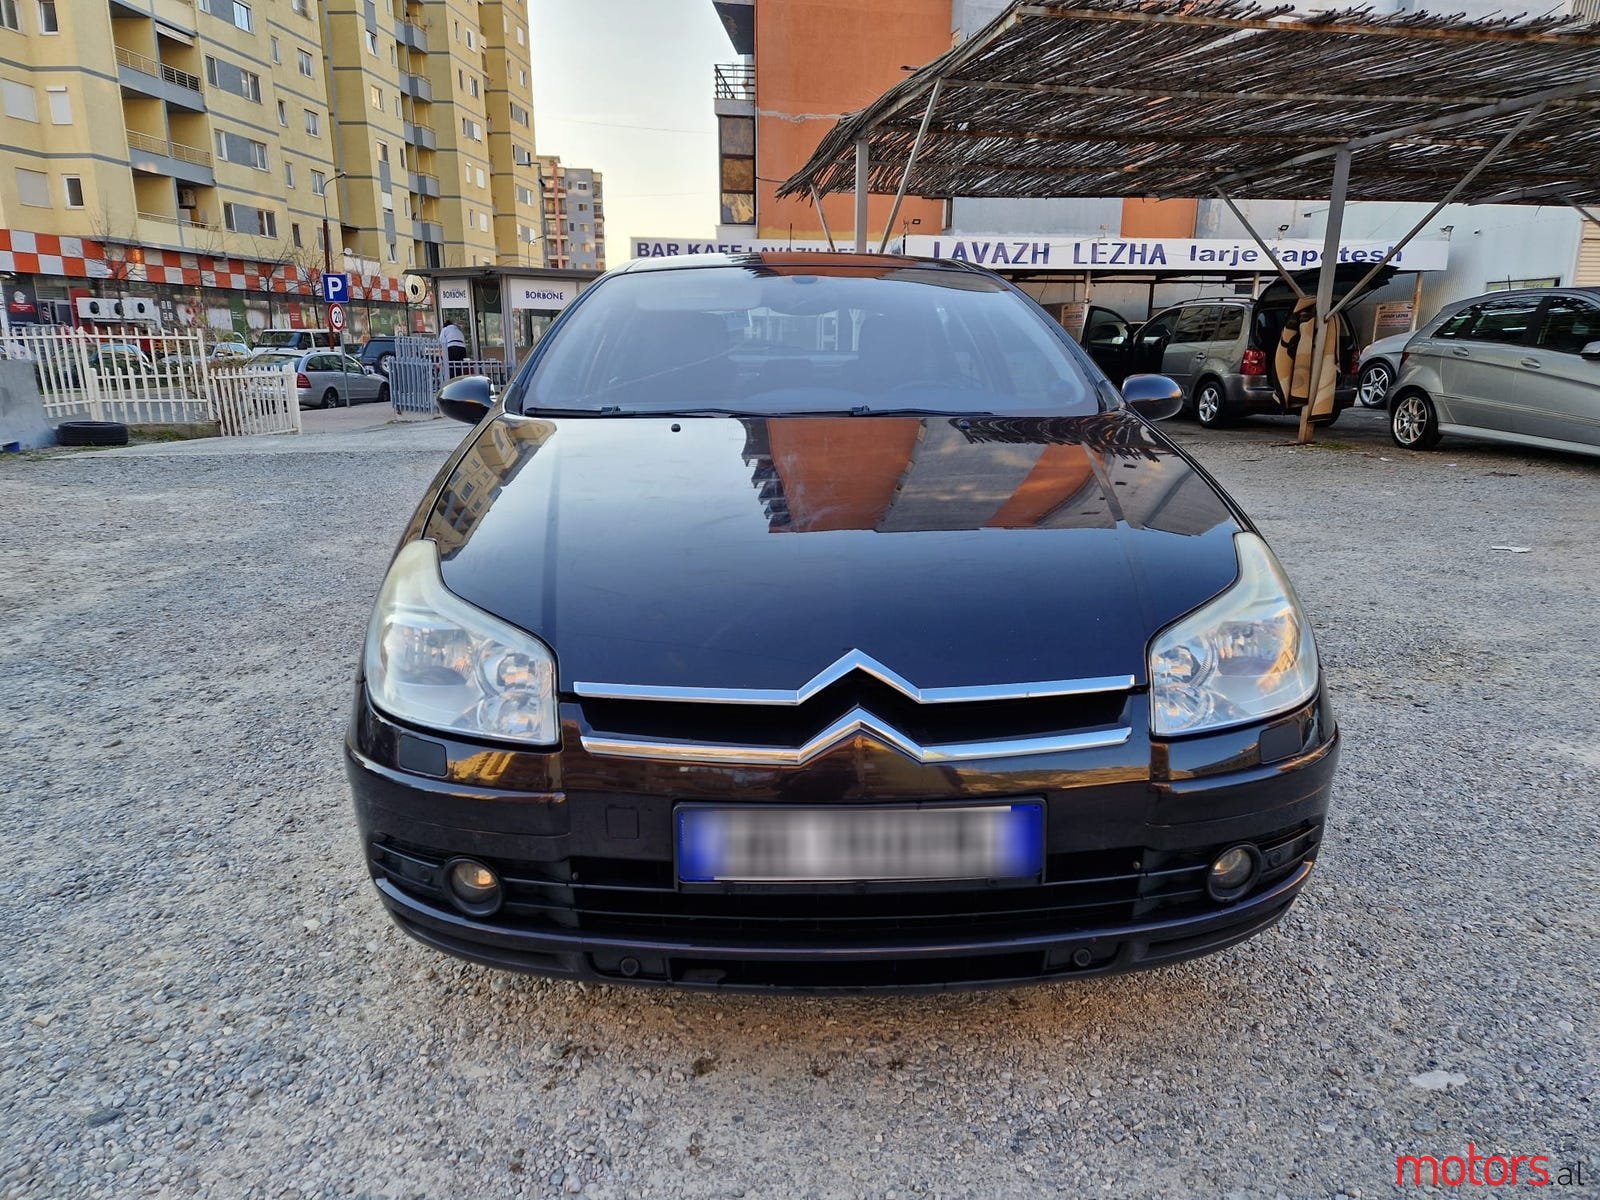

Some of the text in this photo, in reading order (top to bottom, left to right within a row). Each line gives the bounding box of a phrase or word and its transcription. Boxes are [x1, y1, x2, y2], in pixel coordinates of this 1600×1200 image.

[636, 242, 679, 257] BAR
[933, 241, 1402, 266] LAVAZH LEZHA larje taptesh
[327, 277, 342, 299] P
[525, 290, 563, 300] BORBONE
[333, 310, 342, 323] 20
